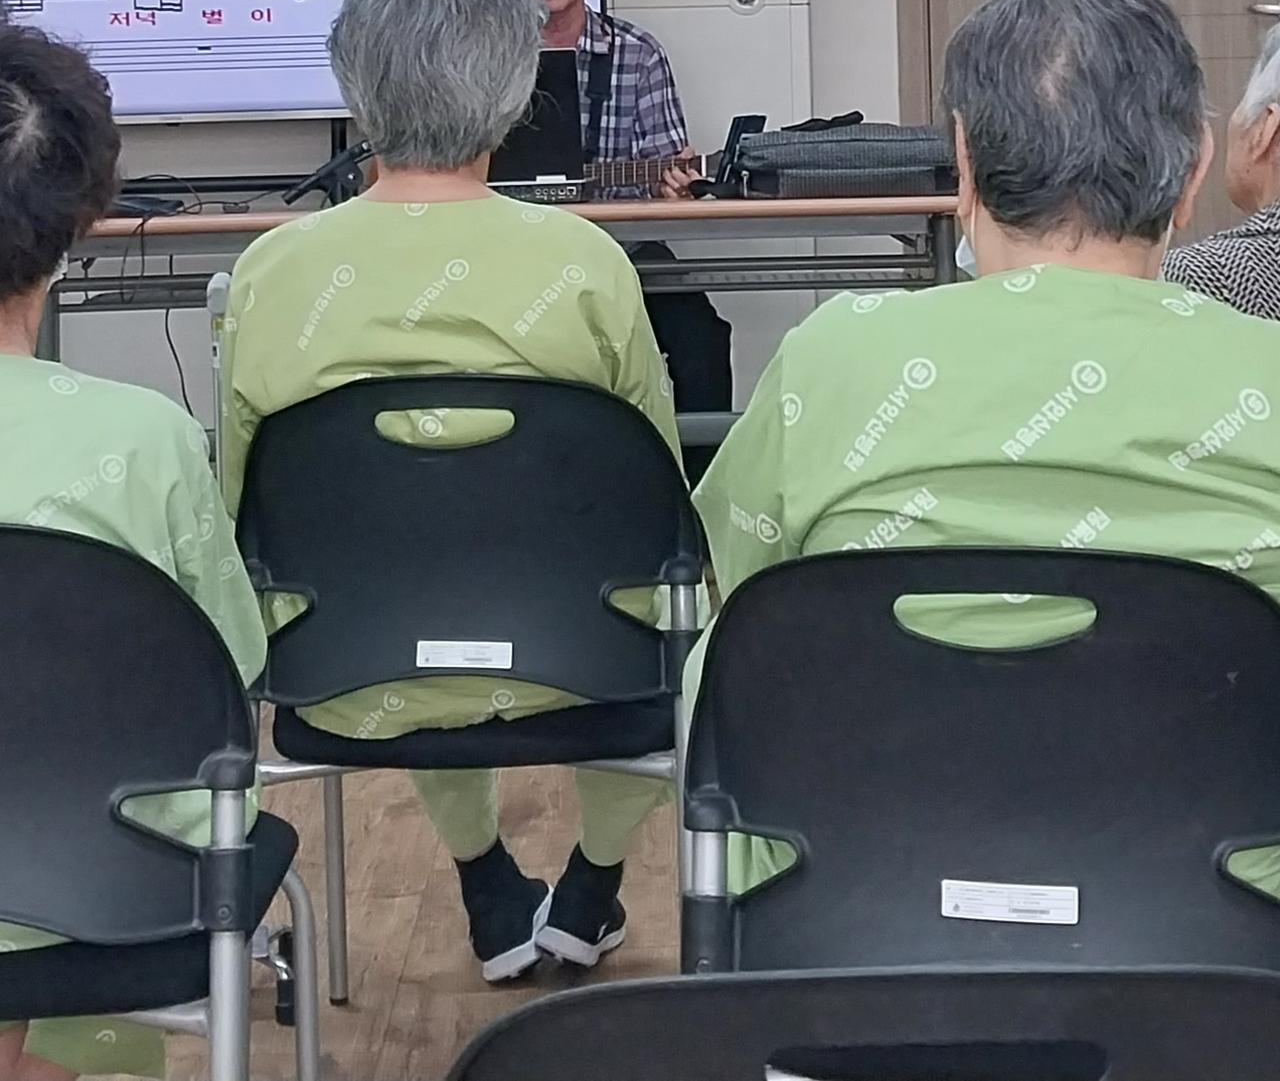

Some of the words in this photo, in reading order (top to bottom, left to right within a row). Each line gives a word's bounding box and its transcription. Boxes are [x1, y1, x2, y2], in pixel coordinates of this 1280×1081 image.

[843, 383, 910, 473] 서안산병원
[1001, 385, 1079, 462] 서안산병원
[1167, 407, 1246, 471] 서안산병원
